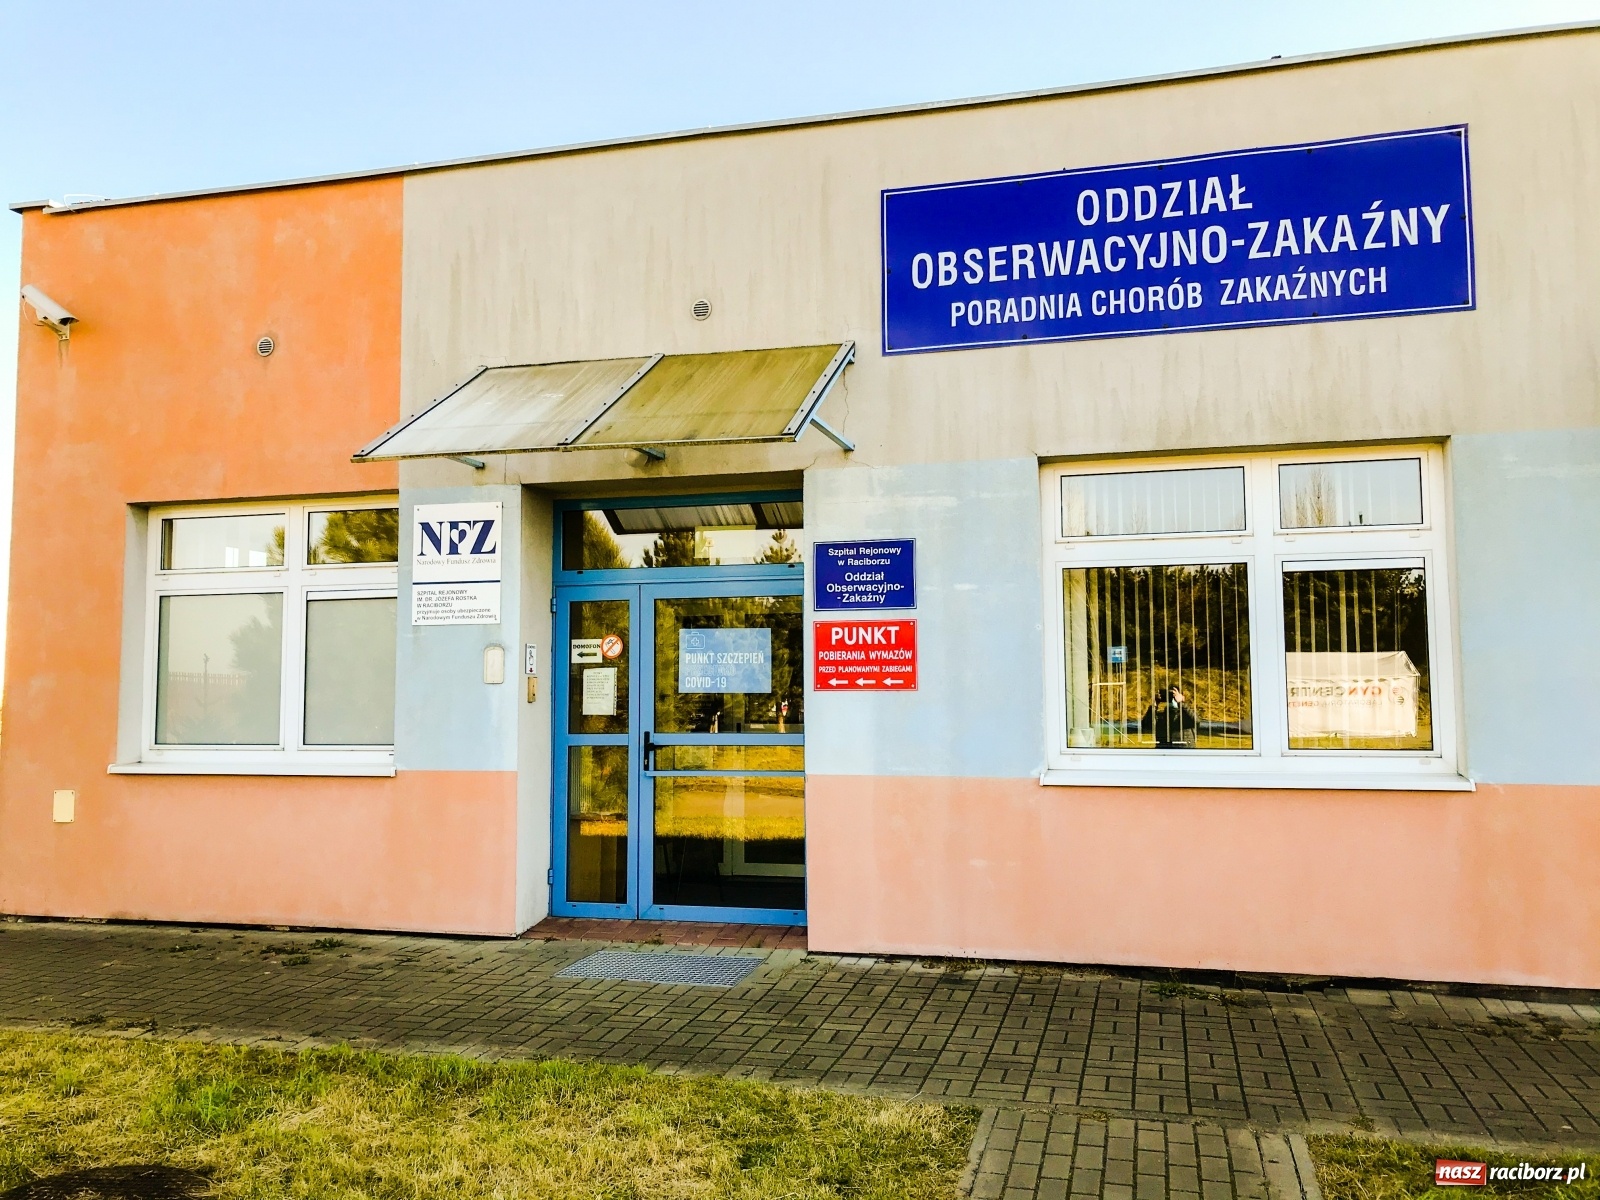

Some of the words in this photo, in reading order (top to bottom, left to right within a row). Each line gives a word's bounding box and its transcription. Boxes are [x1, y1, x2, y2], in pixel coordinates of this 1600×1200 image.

[1076, 172, 1254, 228] ODDZIAŁ
[911, 200, 1451, 291] OBSERWACYJNO-ZAKAŹNY
[950, 292, 1083, 328] PORADNIA
[1091, 276, 1203, 317] CHORÓB
[1219, 265, 1388, 307] ZAKAŹNYCH
[417, 519, 497, 557] NFZ
[828, 548, 857, 557] Szpital
[859, 547, 902, 556] Rejonowy
[417, 559, 445, 567] Narodowy
[847, 557, 891, 566] Raciborzu
[844, 572, 885, 581] Oddział
[826, 582, 905, 594] Obserwacyjno-
[831, 626, 900, 645] PUNKT
[685, 652, 715, 664] PUNKT
[716, 650, 764, 664] SZCZEPIEŃ
[818, 650, 866, 661] POBIERANIA
[869, 647, 913, 660] WYMAZÓW
[838, 665, 880, 673] PLANOWANYMI
[685, 676, 727, 688] COVID-19
